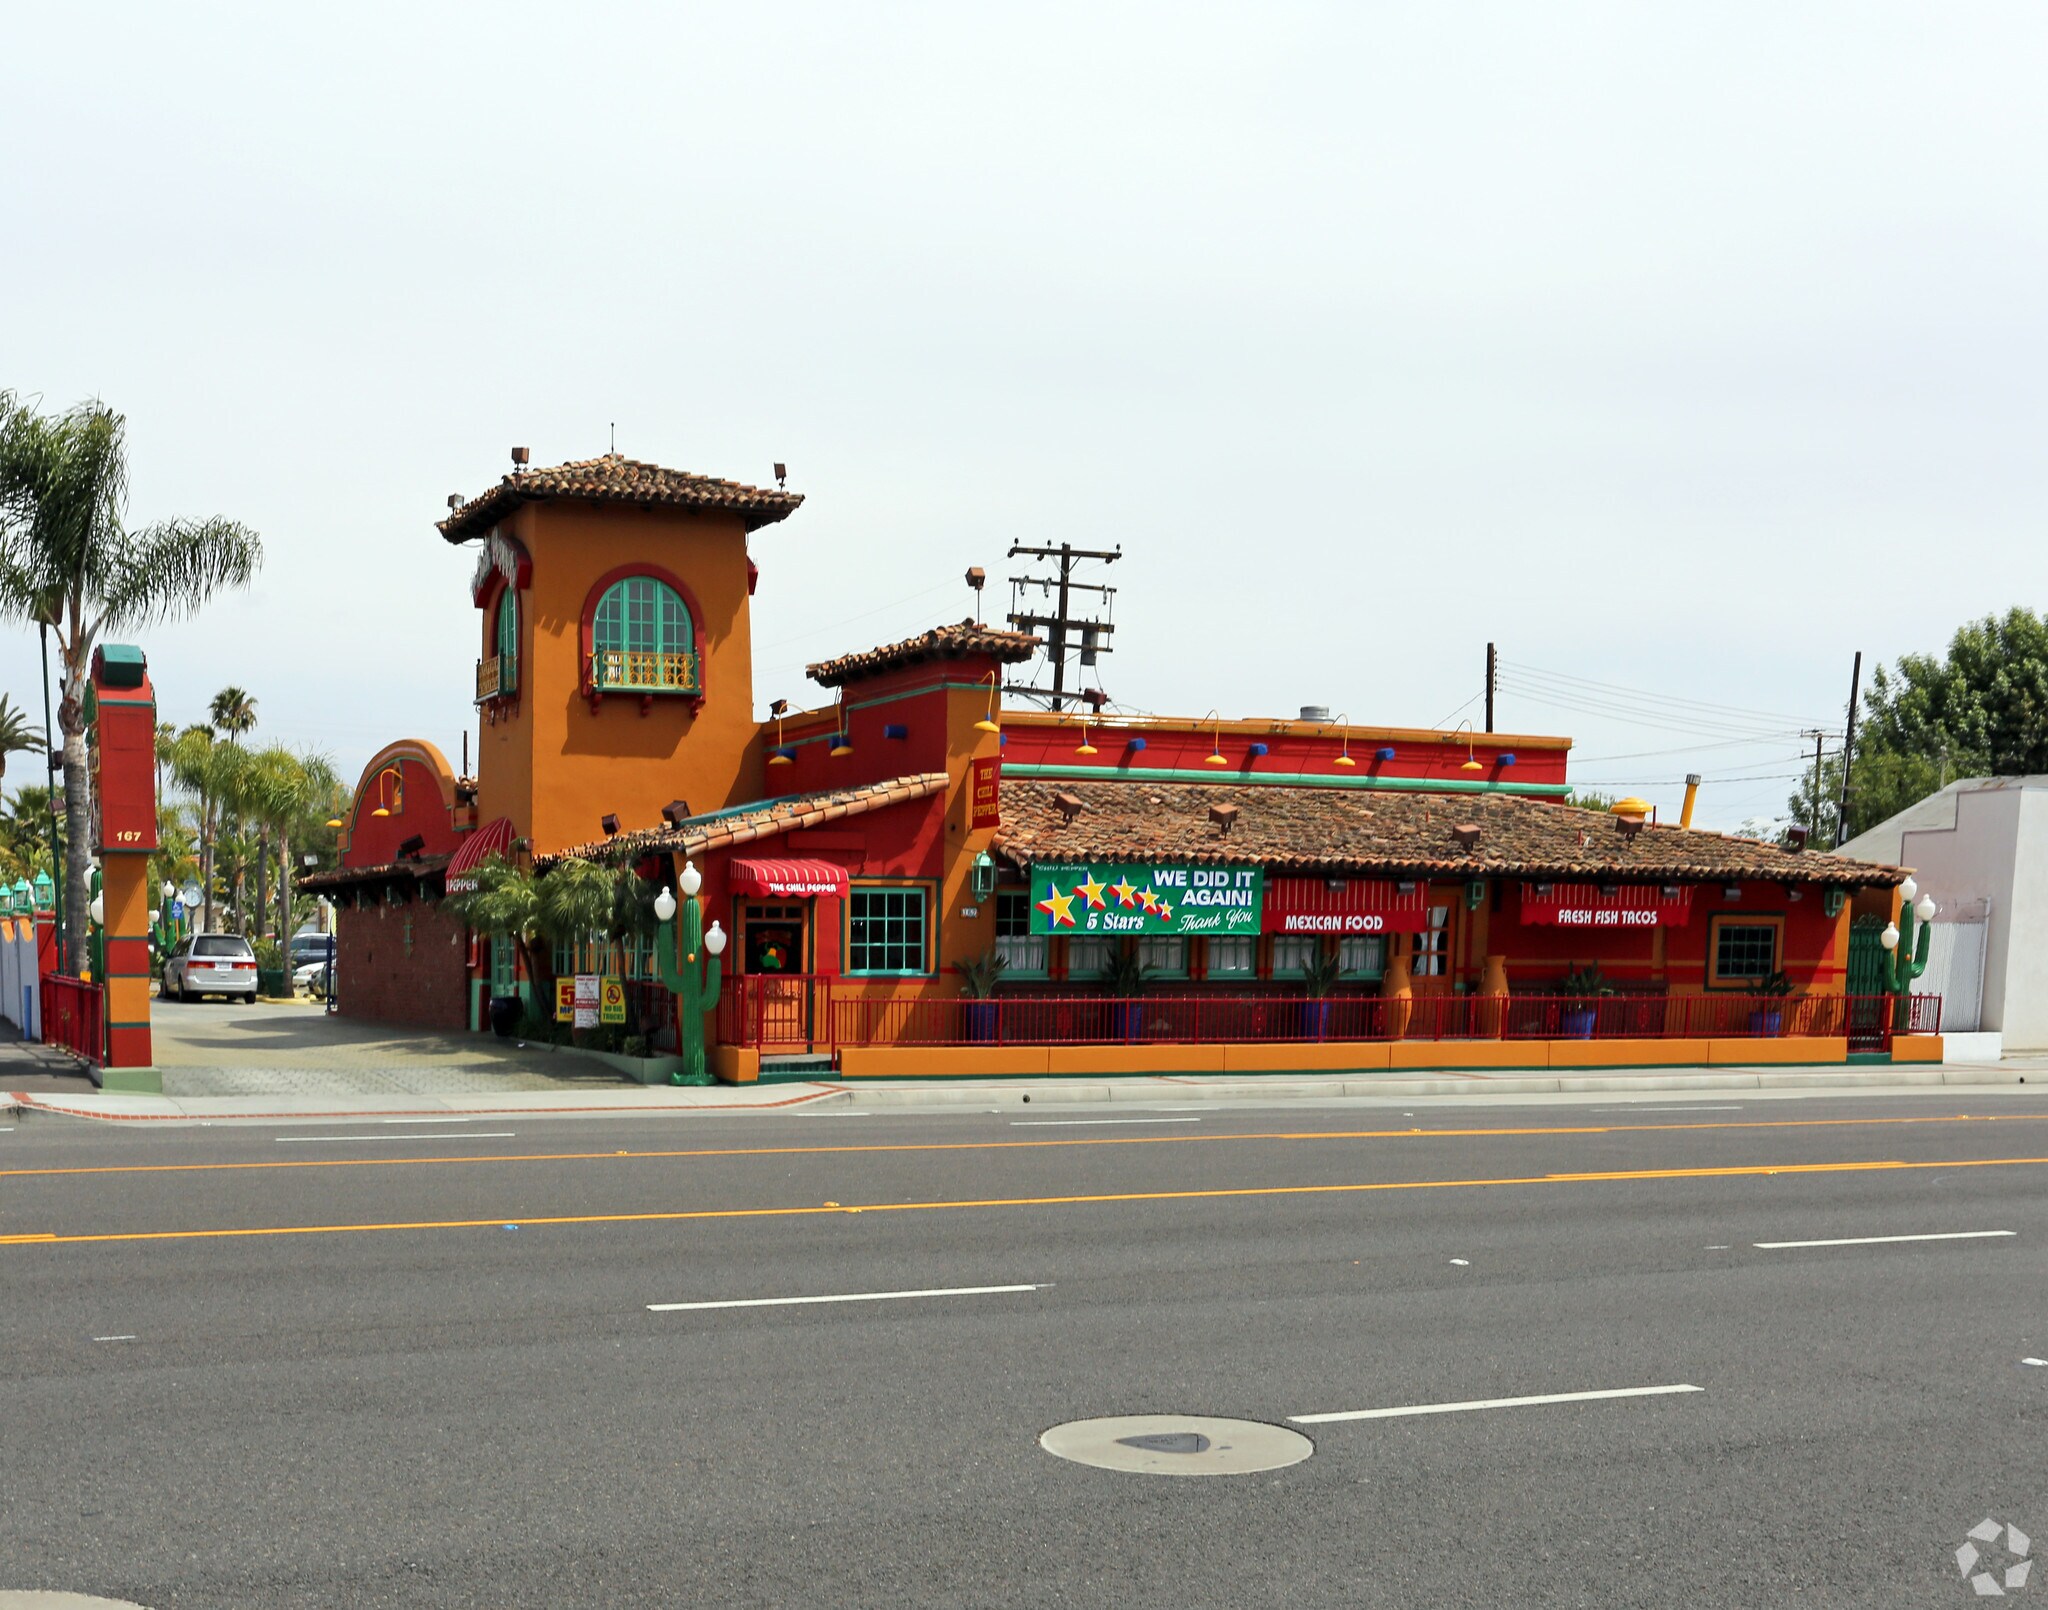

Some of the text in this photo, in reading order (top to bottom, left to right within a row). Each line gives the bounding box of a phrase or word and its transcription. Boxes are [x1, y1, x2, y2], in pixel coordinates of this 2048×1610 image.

[980, 767, 993, 781] THE
[978, 785, 993, 799] CHILI
[973, 803, 997, 817] PEPPER
[116, 831, 142, 842] 167
[1153, 870, 1255, 887] WE DID IT
[769, 883, 837, 893] THE CHILI PEPPER
[1180, 889, 1253, 906] AGAIN!
[1086, 912, 1145, 930] 5 Stars
[1177, 907, 1254, 932] Thank You
[1285, 914, 1384, 931] MEXICAN FOOD
[1558, 909, 1658, 925] FRESH FISH TACOS
[561, 985, 576, 1006] 5
[560, 1006, 573, 1014] MP
